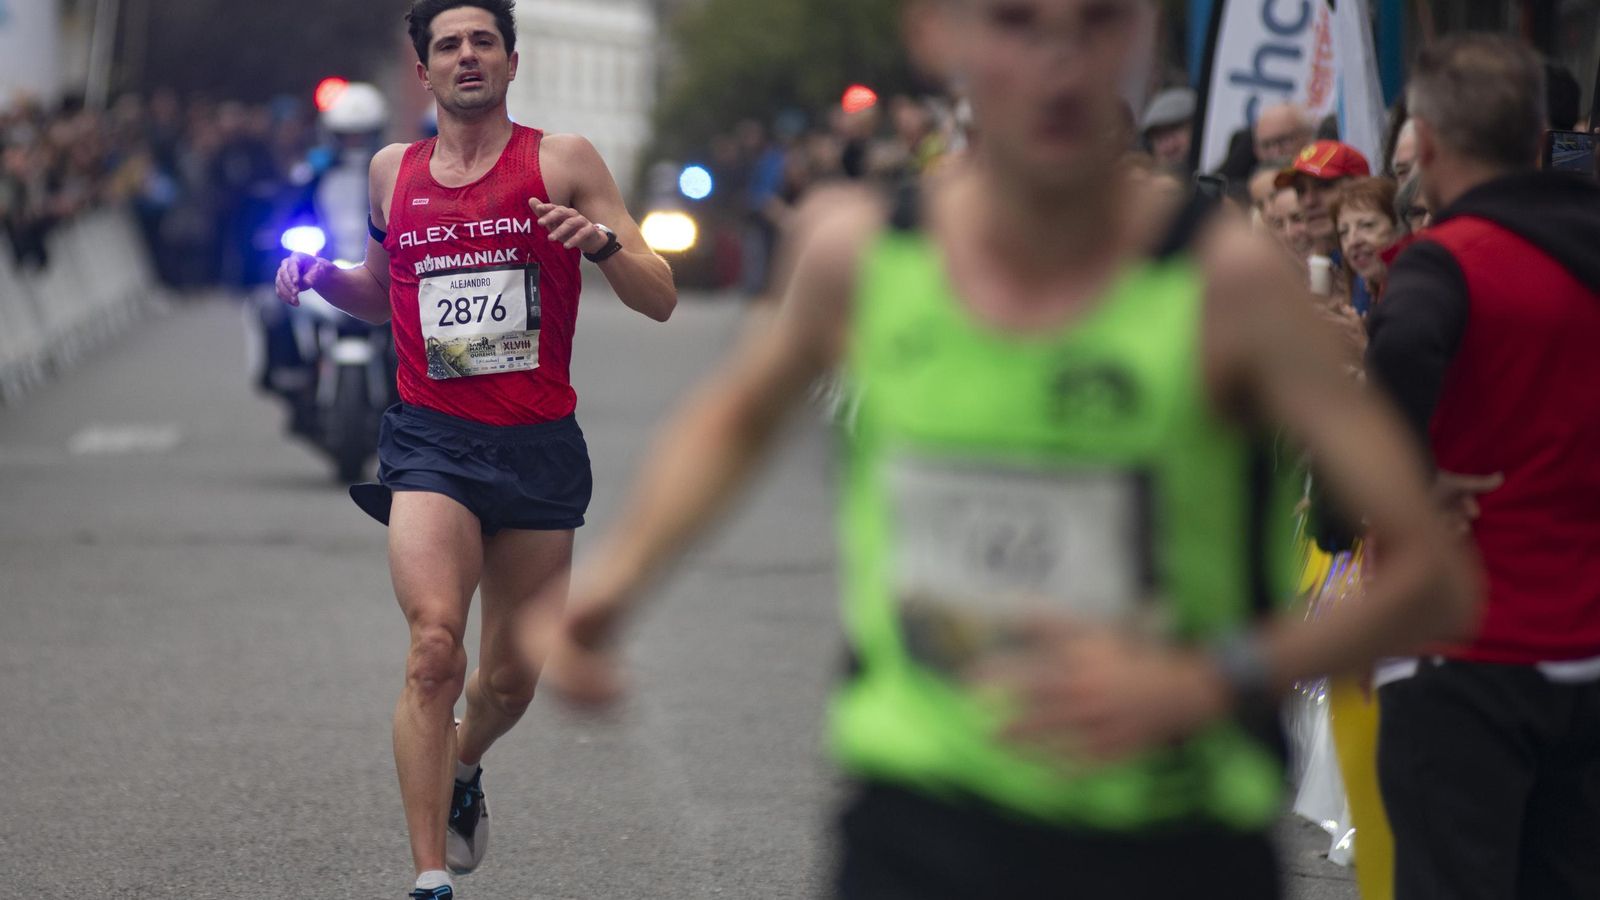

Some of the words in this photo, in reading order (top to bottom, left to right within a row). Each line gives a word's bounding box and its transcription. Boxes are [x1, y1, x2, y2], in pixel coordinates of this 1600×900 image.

[399, 224, 458, 249] ALEX
[464, 217, 531, 238] TEAM
[450, 278, 491, 290] ALEJANDRO
[437, 293, 507, 327] 2876
